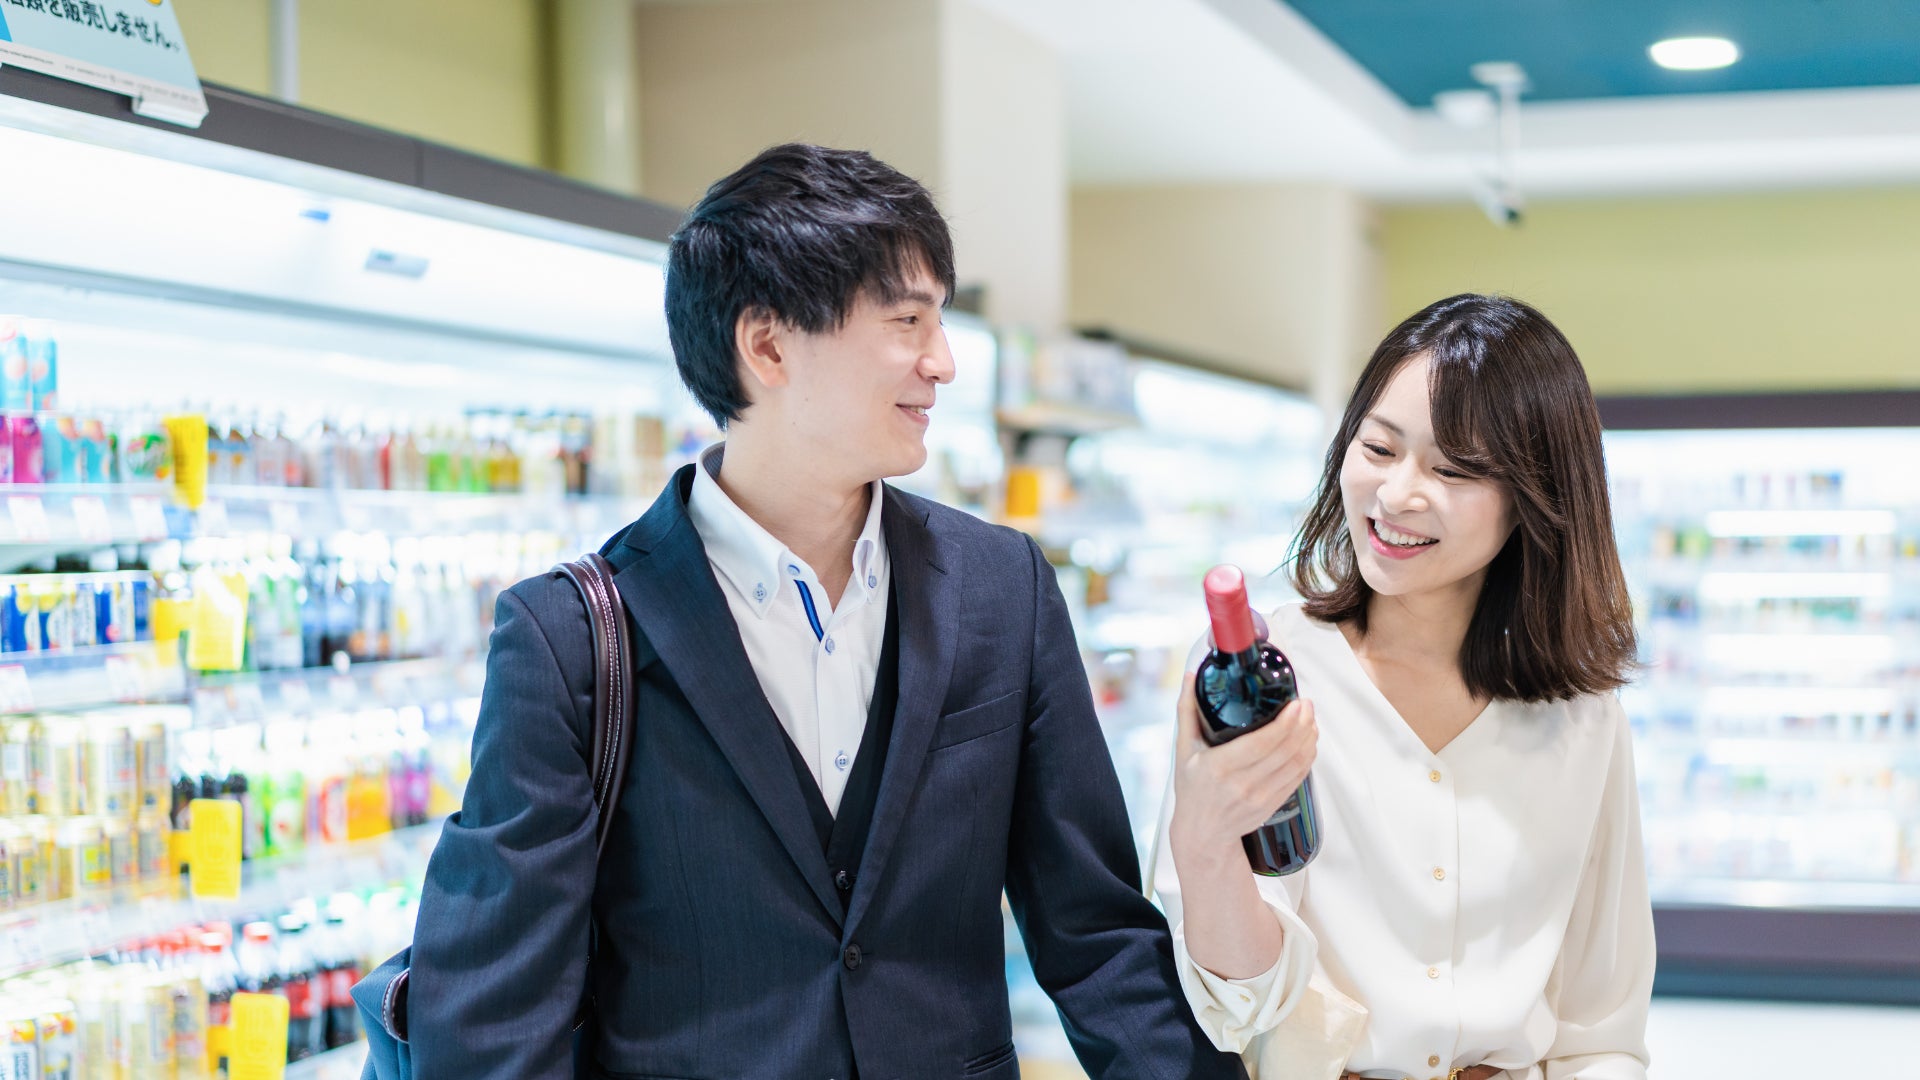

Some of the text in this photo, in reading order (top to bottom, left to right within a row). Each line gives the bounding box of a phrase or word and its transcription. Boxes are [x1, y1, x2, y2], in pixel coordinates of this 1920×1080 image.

[5, 0, 180, 52] 類を販売しません。
